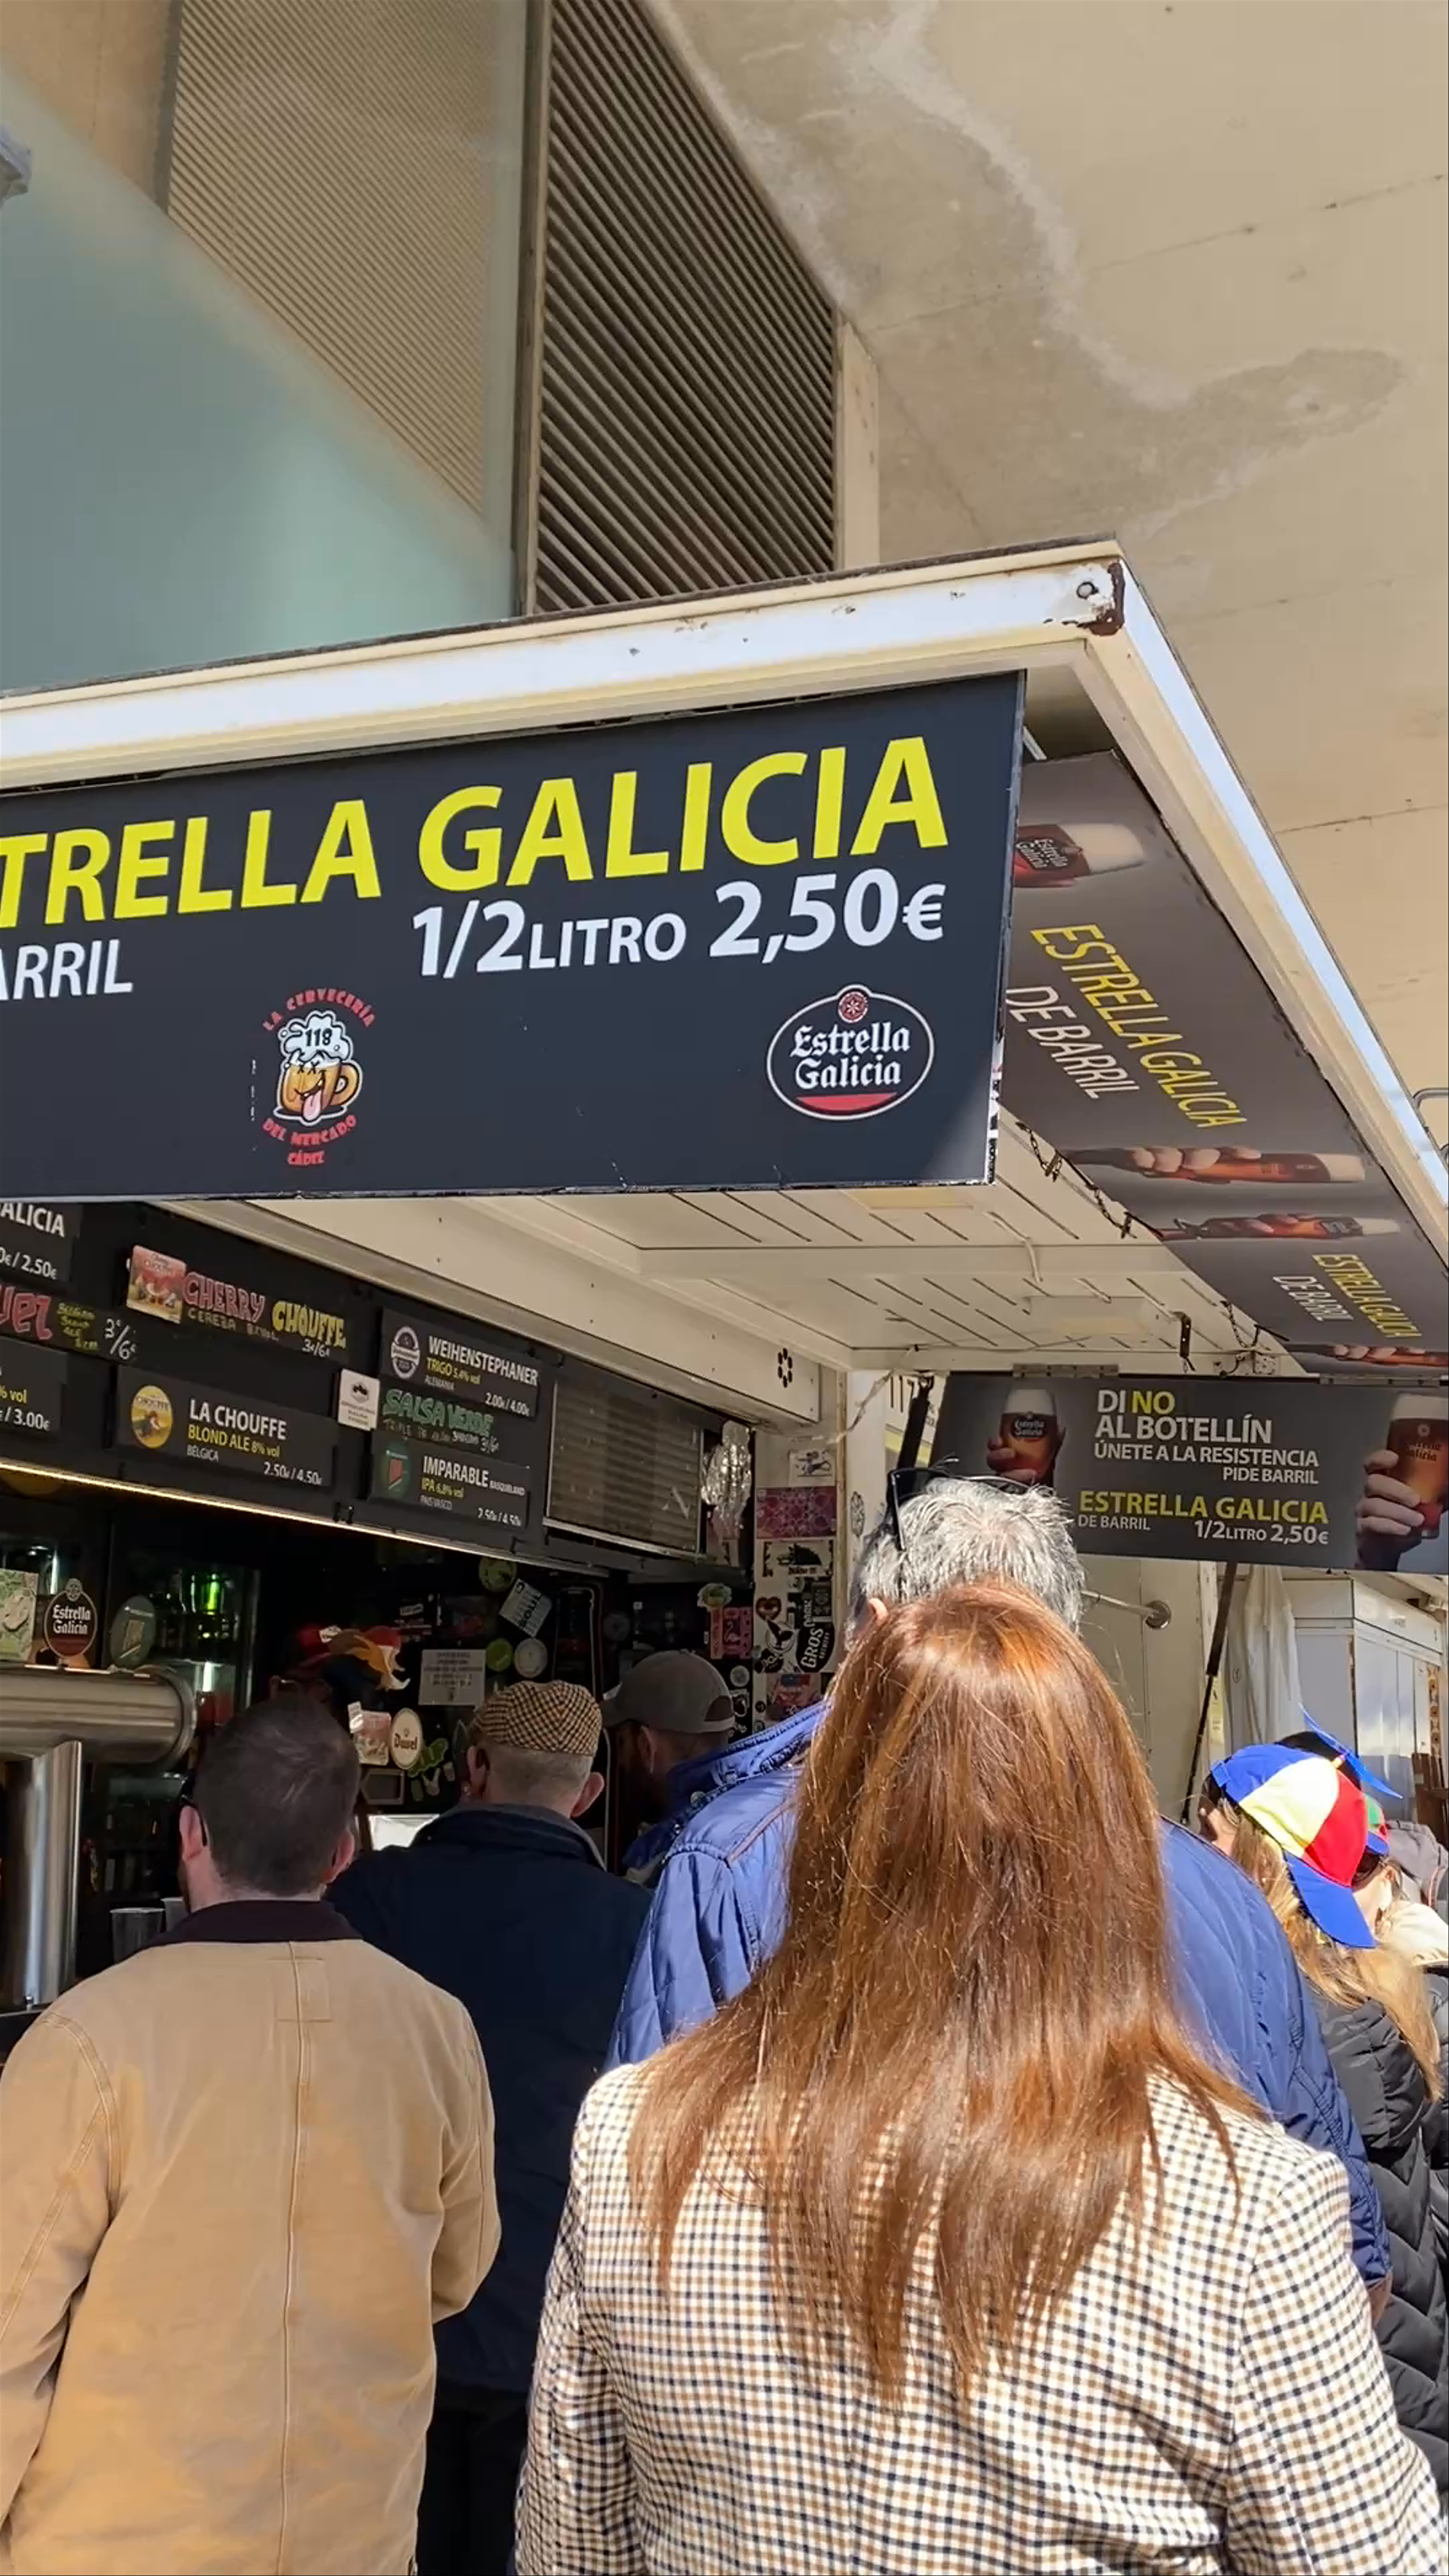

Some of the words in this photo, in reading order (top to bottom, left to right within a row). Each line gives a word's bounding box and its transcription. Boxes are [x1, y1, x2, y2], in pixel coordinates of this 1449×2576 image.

[0, 800, 381, 928] TRELLA
[418, 737, 948, 890] GALICIA
[710, 868, 946, 963] 2,50€
[0, 939, 133, 1000] RRIL
[263, 1010, 284, 1031] LA
[1005, 986, 1075, 1023] DE
[305, 1028, 332, 1046] 118
[789, 1022, 911, 1057] Estrella
[1030, 924, 1183, 1049] ESTRELLA
[1140, 1051, 1247, 1128] GALICIA
[795, 1054, 901, 1089] Galicia
[1027, 1025, 1140, 1100] BARRIL
[263, 1118, 287, 1141] DEL
[291, 1115, 357, 1146] MERCADO
[1272, 1276, 1326, 1291] DE
[1312, 1254, 1392, 1304] ESTRELLA
[1359, 1304, 1422, 1338] GALICIA
[183, 1271, 265, 1324] CHERRY
[272, 1300, 346, 1349] CHOUFFE
[1289, 1291, 1354, 1321] BARRIL
[427, 1357, 452, 1376] TRIGO
[428, 1335, 539, 1386] WEIHENSTEPHANER
[10, 1389, 27, 1404] vol
[383, 1389, 446, 1427] SALSA
[1097, 1389, 1126, 1413] DI
[1131, 1391, 1175, 1415] NO
[190, 1399, 210, 1423] LA
[214, 1405, 287, 1441] CHOUFFE
[1095, 1415, 1131, 1439] AL
[1137, 1415, 1272, 1444] BOTELLÍN
[188, 1424, 227, 1446] BLOND
[229, 1435, 250, 1452] ALE
[251, 1441, 265, 1455] 8%
[266, 1445, 280, 1458] vol
[1095, 1441, 1152, 1460] ÚNETE
[1158, 1446, 1169, 1461] A
[1173, 1446, 1196, 1463] LA
[1200, 1448, 1318, 1467] RESISTENCIA
[422, 1477, 435, 1492] IPA
[423, 1455, 489, 1489] IMPARABLE
[1223, 1467, 1258, 1483] PIDE
[1262, 1468, 1319, 1485] BARRIL
[1079, 1491, 1208, 1518] ESTRELLA
[1216, 1497, 1328, 1524] GALICIA
[1078, 1515, 1097, 1529] DE
[1101, 1516, 1151, 1531] BARRIL
[1270, 1524, 1329, 1545] 2,50€
[52, 1604, 91, 1621] Estrella
[52, 1620, 88, 1635] Galicia
